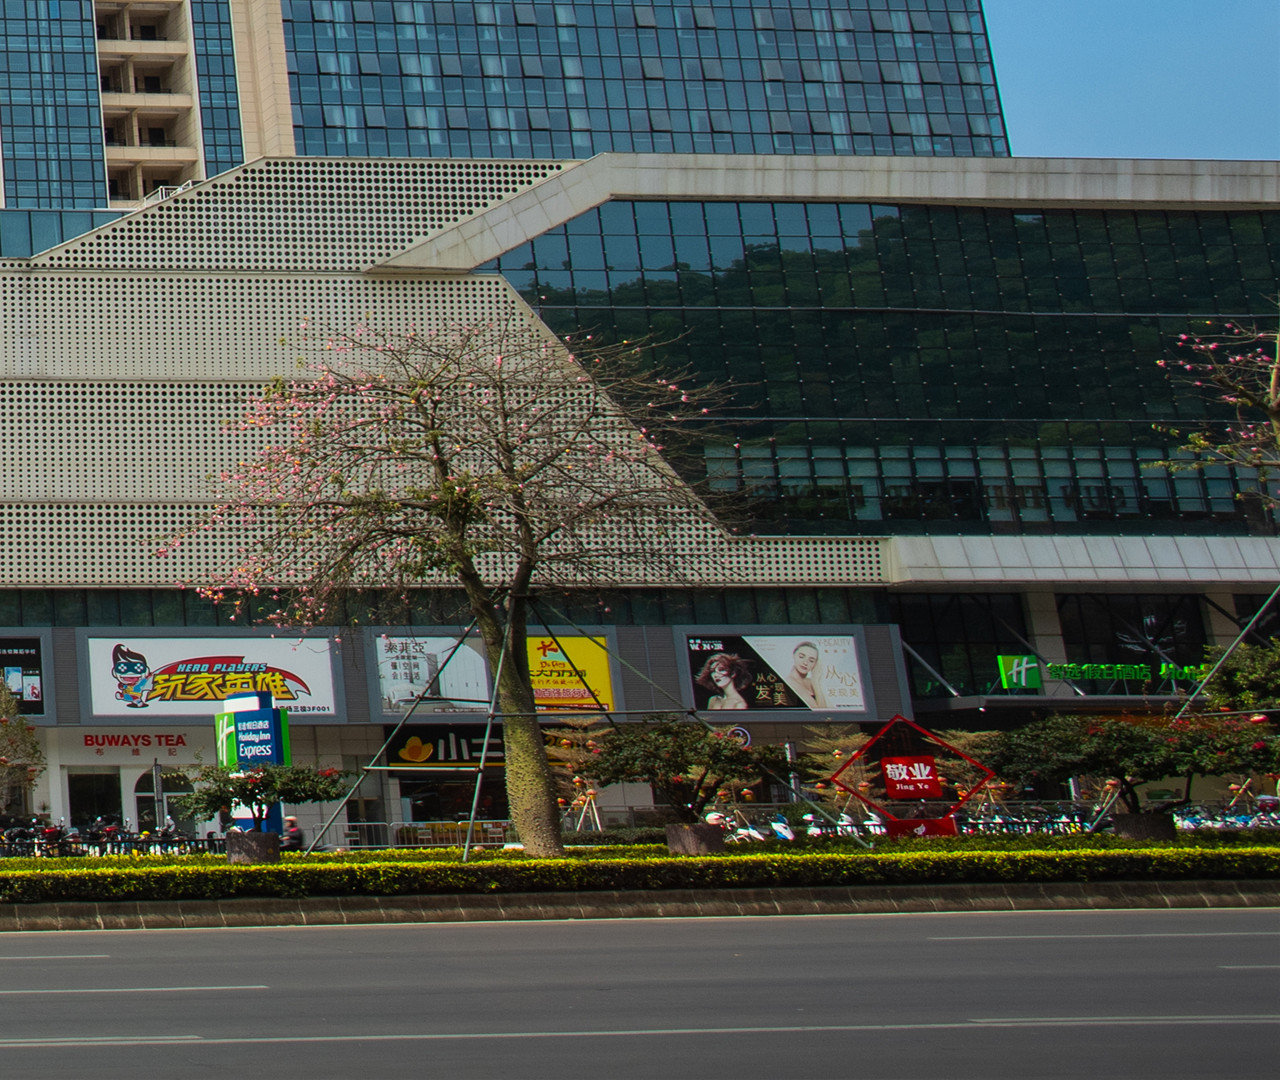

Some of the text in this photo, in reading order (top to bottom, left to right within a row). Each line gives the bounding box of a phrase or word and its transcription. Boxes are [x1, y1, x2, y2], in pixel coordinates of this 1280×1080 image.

[176, 663, 268, 672] HERO PLAYERS
[149, 672, 294, 701] 玩家英雄
[84, 734, 187, 747] BUWAYS TEA
[238, 731, 271, 743] Holiday Inn
[239, 743, 272, 759] Express
[885, 763, 933, 781] 敬业
